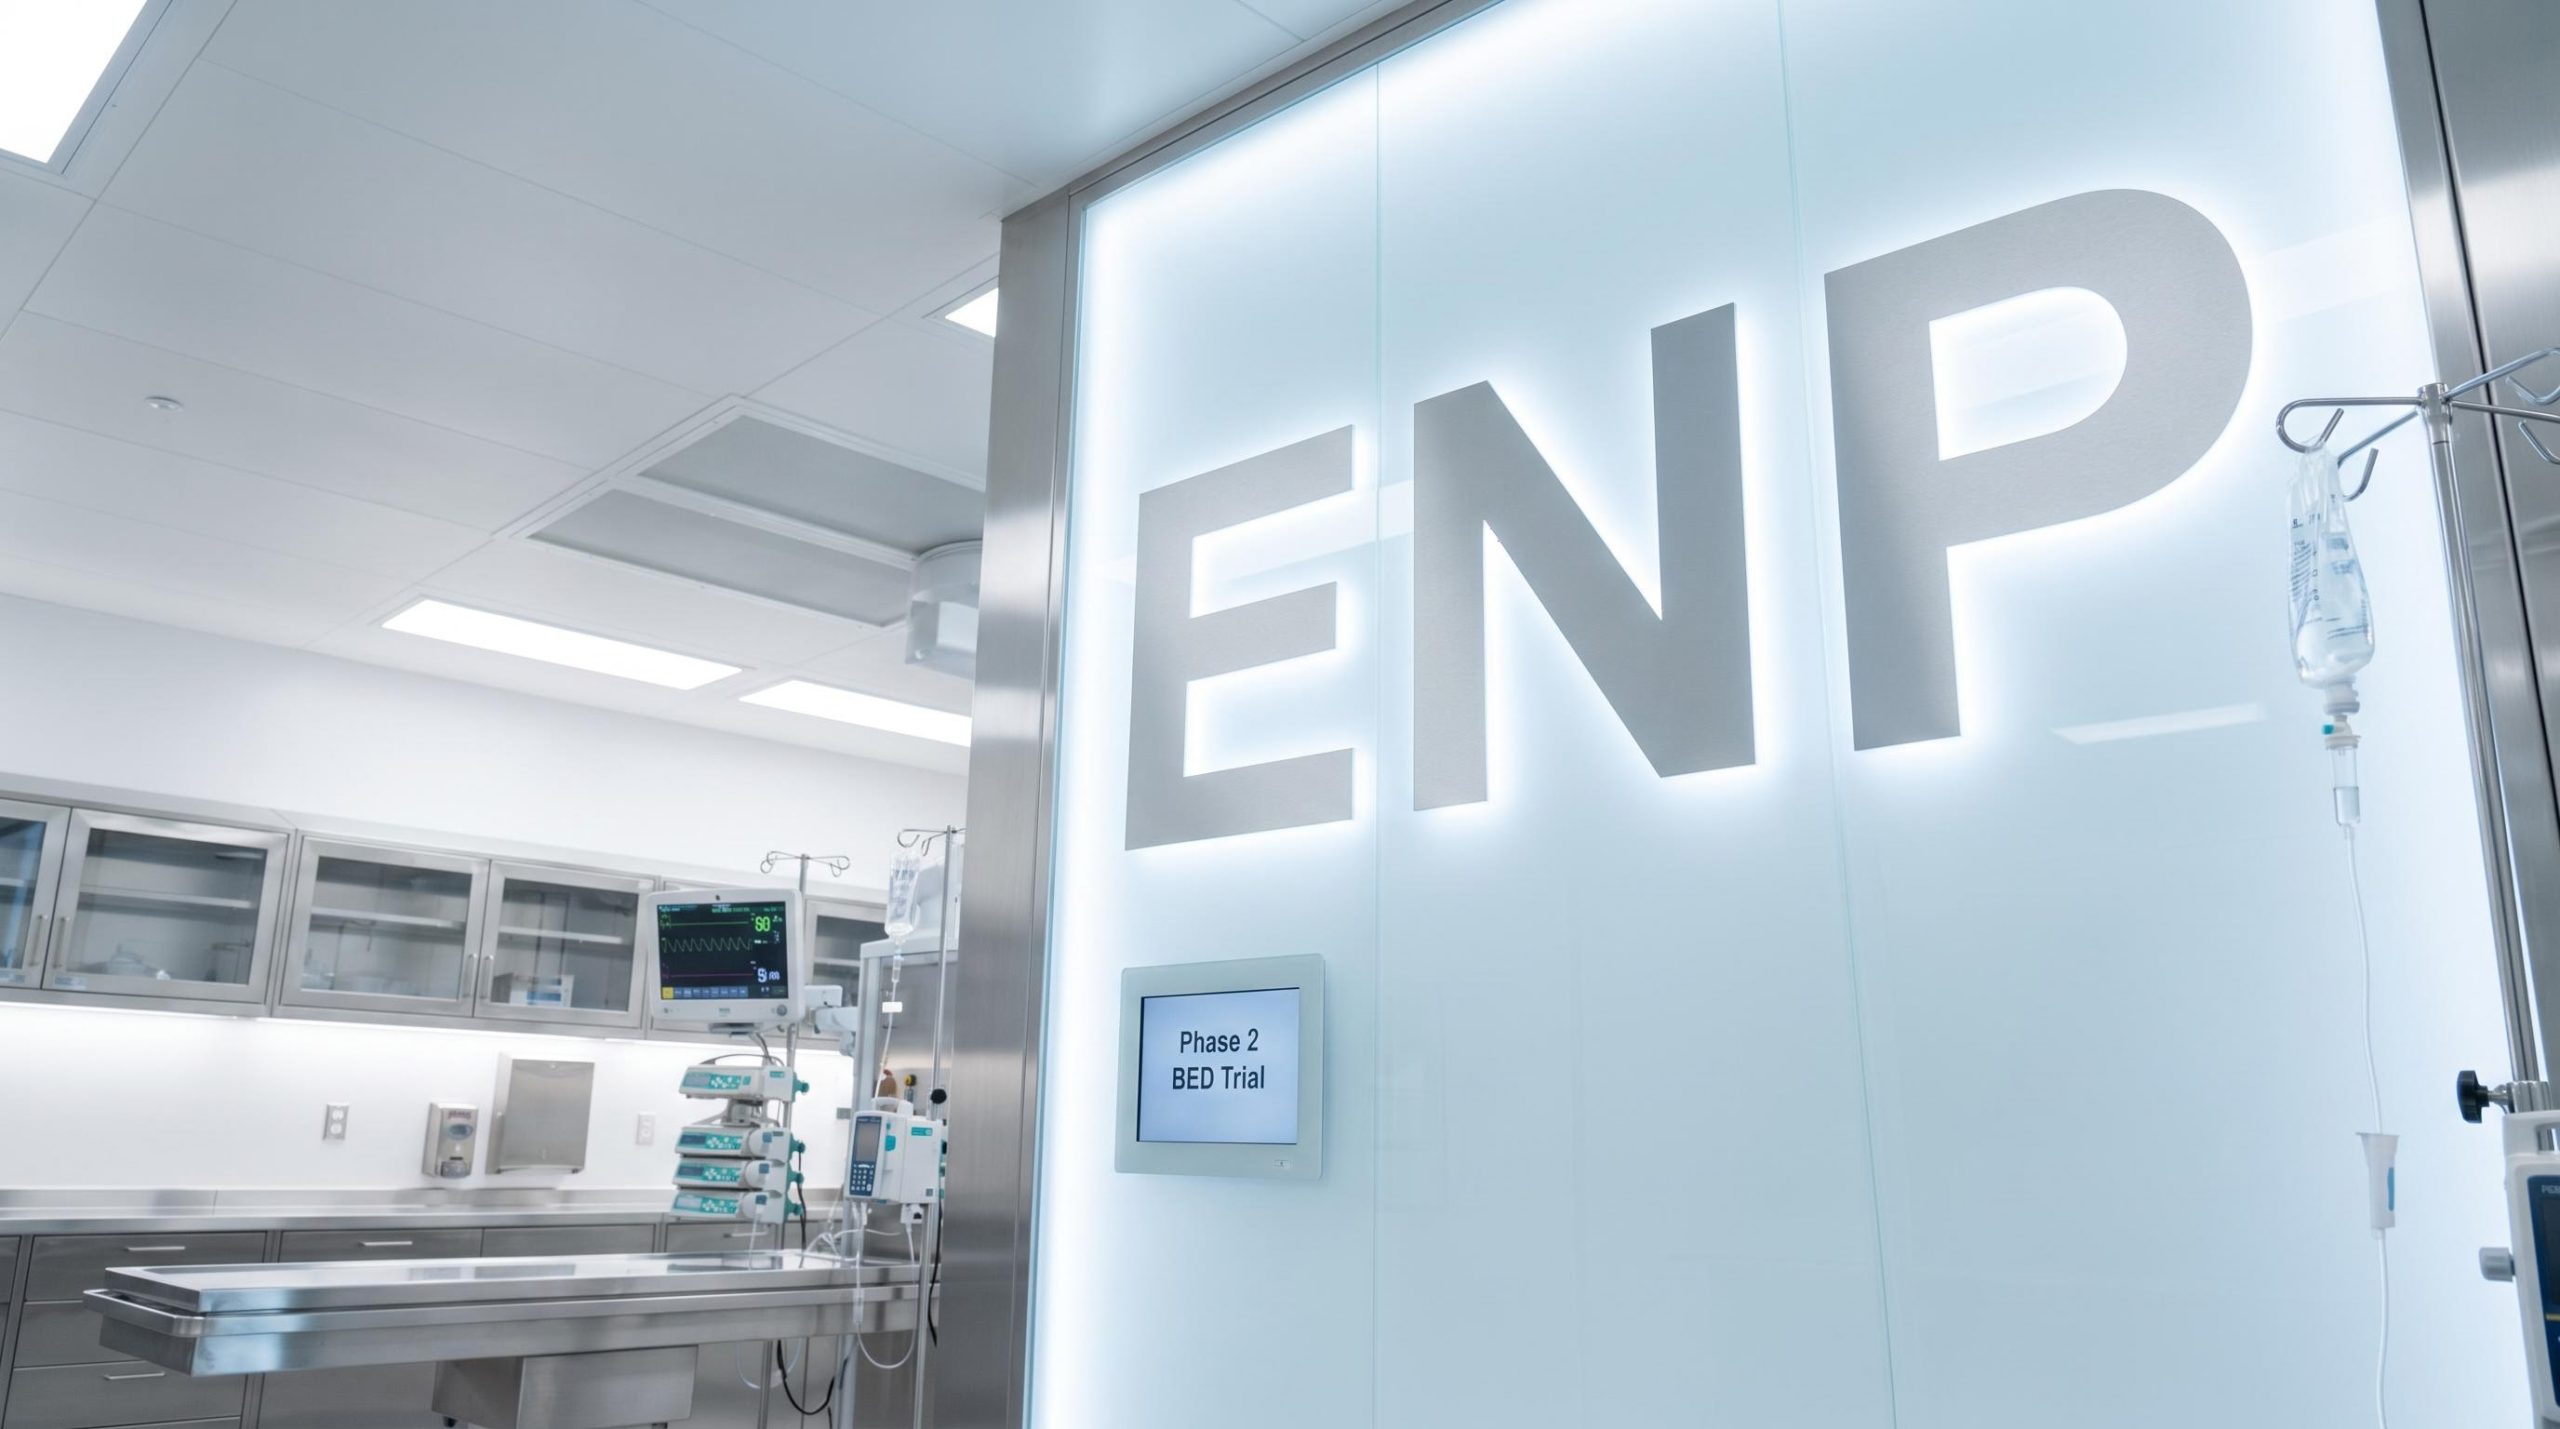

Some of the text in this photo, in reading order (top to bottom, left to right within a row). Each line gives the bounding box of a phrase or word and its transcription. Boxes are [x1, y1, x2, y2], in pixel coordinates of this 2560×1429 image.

[1125, 188, 2253, 852] ENP
[1179, 1027, 1260, 1054] Phase 2
[1172, 1064, 1266, 1090] BED Trial
